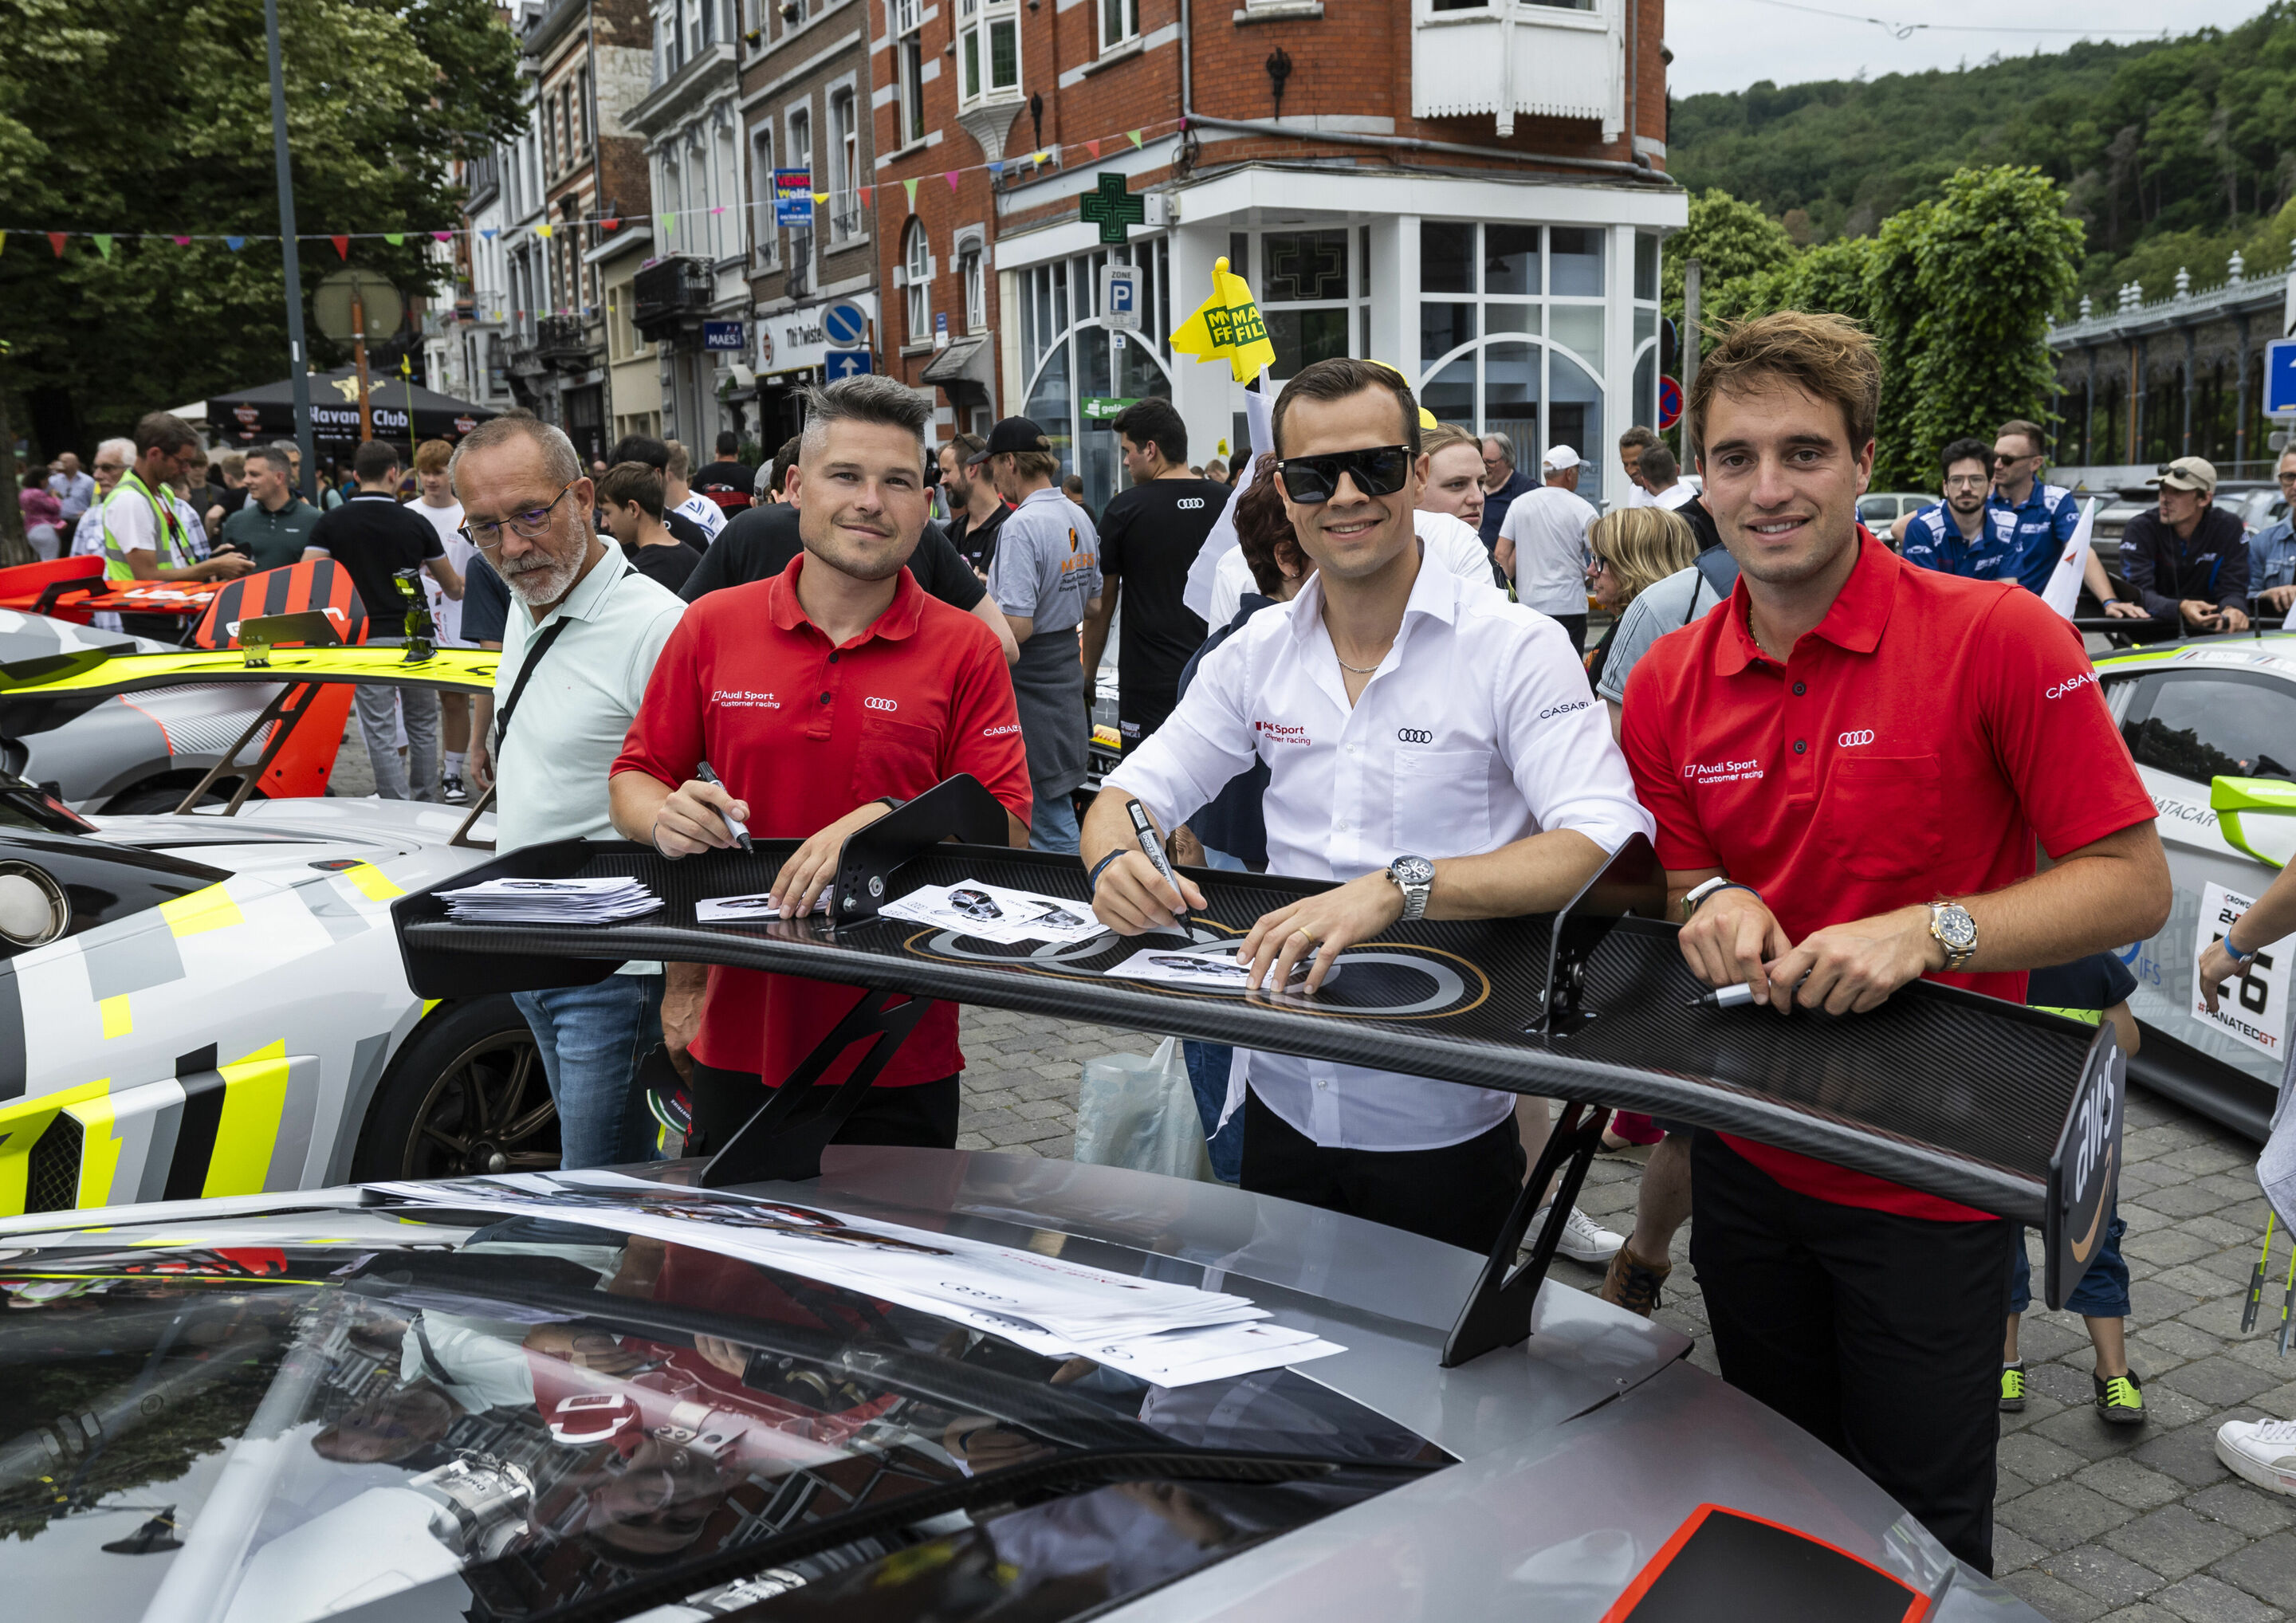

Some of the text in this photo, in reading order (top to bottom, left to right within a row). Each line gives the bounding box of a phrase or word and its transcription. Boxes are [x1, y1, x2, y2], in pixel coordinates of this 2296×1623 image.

[1113, 285, 1130, 309] P
[709, 334, 737, 345] MAES
[798, 322, 824, 345] Twiste
[309, 405, 408, 427] Havan Club
[2046, 672, 2099, 699] CASA
[721, 690, 774, 701] Audi Sport
[1540, 701, 1592, 719] CASA
[983, 725, 1021, 737] CASA
[1275, 725, 1304, 736] Sport
[1287, 737, 1311, 746] racing
[1697, 759, 1757, 775] Audi Sport
[1698, 770, 1763, 784] customer racing
[2226, 894, 2251, 909] CROWD
[2139, 957, 2161, 985] IFS
[2075, 1044, 2117, 1204] aws
